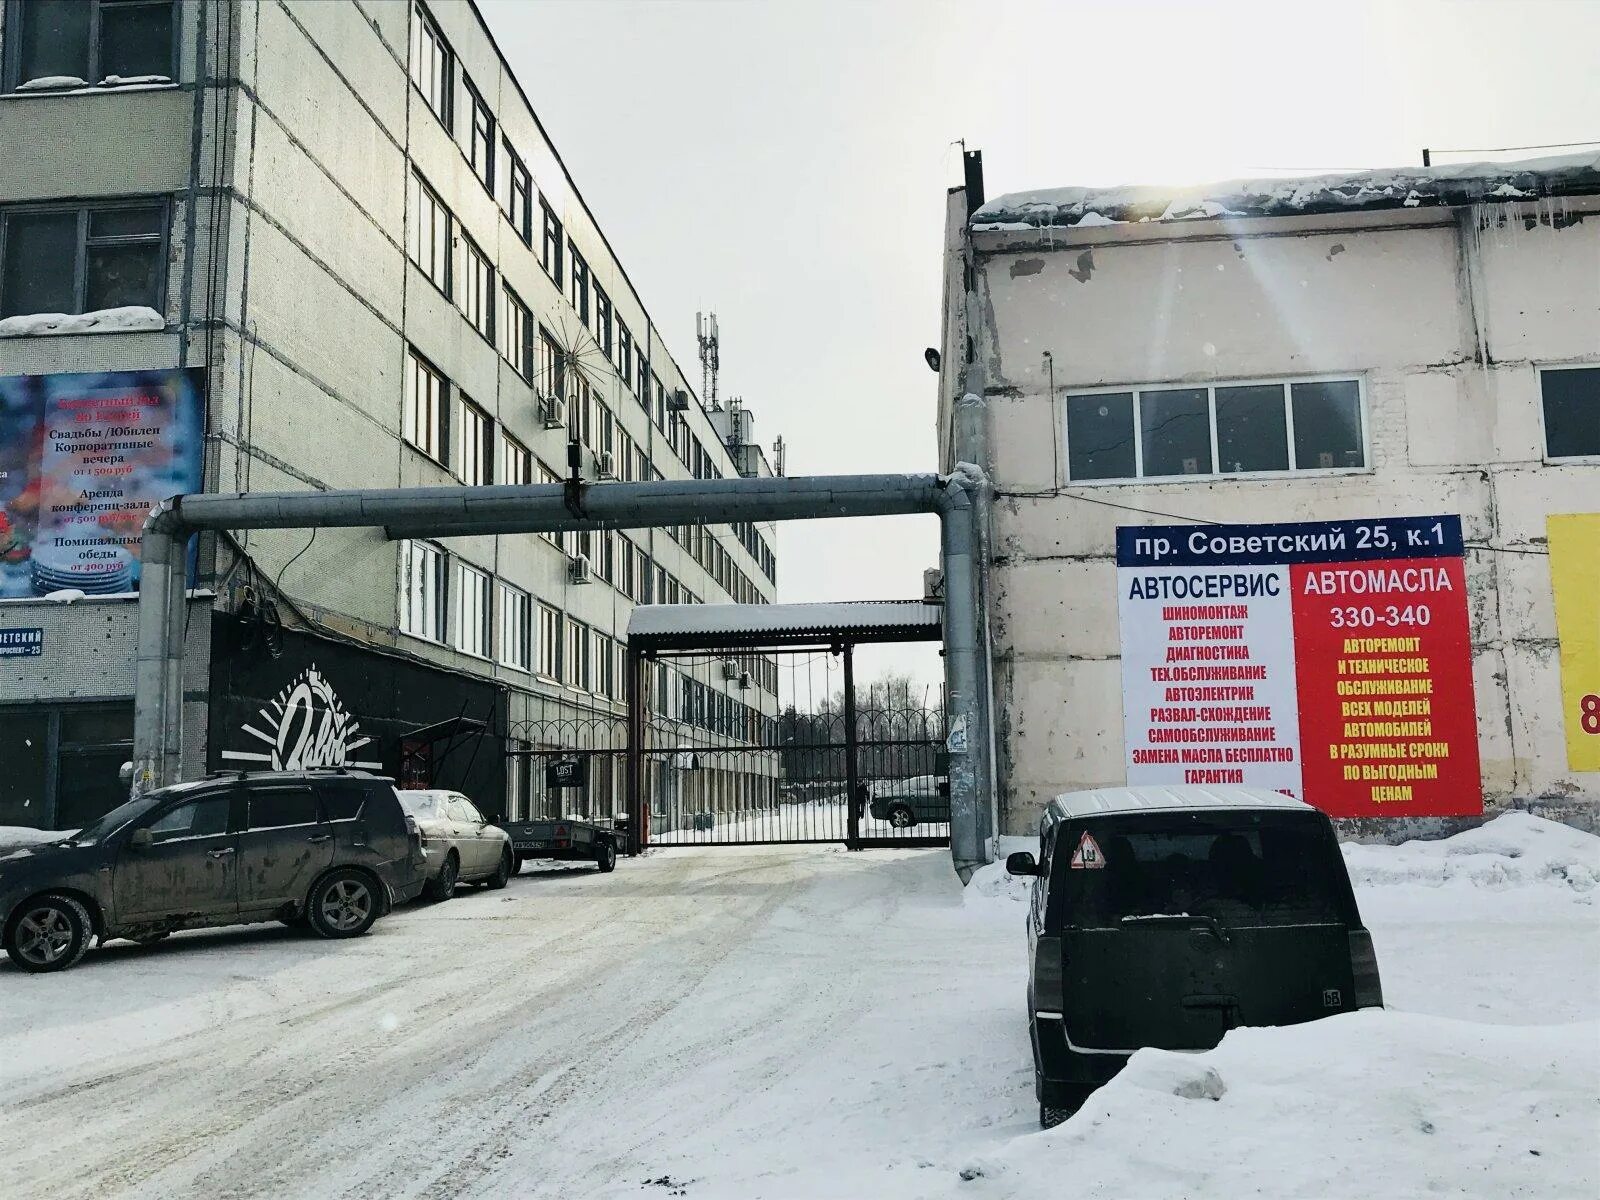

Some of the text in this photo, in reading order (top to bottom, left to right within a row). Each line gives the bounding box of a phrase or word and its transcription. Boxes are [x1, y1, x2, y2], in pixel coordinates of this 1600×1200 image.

[49, 428, 101, 440] Свадьбы
[55, 440, 154, 454] Корпоративные
[83, 455, 125, 465] вечера
[94, 467, 112, 476] 500
[115, 465, 133, 477] руб
[80, 489, 124, 500] Аренда
[51, 501, 150, 513] конференц-зала
[77, 516, 96, 525] 500
[55, 536, 142, 548] Поминальные
[1135, 522, 1444, 560] пр. Советский 25, к.1
[79, 550, 117, 560] обеды
[84, 564, 104, 573] 400
[106, 562, 124, 573] руб
[1129, 572, 1280, 600] АВТОСЕРВИС
[1303, 567, 1453, 595] АВТОМАСЛА
[1162, 605, 1248, 621] ШИНОМОНТАЖ
[1330, 605, 1431, 628] 330-340
[1168, 625, 1244, 641] АВТОРЕМОНТ
[1166, 645, 1250, 663] ДИАГНОСТИКА
[1343, 637, 1421, 654] АВТОРЕМОНТ
[1150, 665, 1267, 682] ТЕХ.ОБСЛУЖИВАНИЕ
[1338, 658, 1430, 675] И ТЕХНИЧЕСКОЕ
[1165, 686, 1255, 702] АВТОЭЛЕКТРИК
[1337, 679, 1434, 696] ОБСЛУЖИВАНИЕ
[1150, 706, 1272, 723] РАЗВАЛ-СХОЖДЕНИЕ
[1341, 697, 1431, 718] ВСЕХ МОДЕЛЕЙ
[1148, 727, 1276, 743] САМООБСЛУЖИВАНИЕ
[1344, 718, 1432, 738] АВТОМОБИЛЕЙ
[1132, 747, 1294, 764] ЗАМЕНА МАСЛА БЕСПЛАТНО
[1329, 742, 1449, 759] В РАЗУМНЫЕ СРОКИ
[1184, 769, 1243, 784] ГАРАНТИЯ
[1343, 763, 1438, 781] ПО ВЫГОДНЫМ
[1371, 785, 1413, 803] ЦЕНАМ
